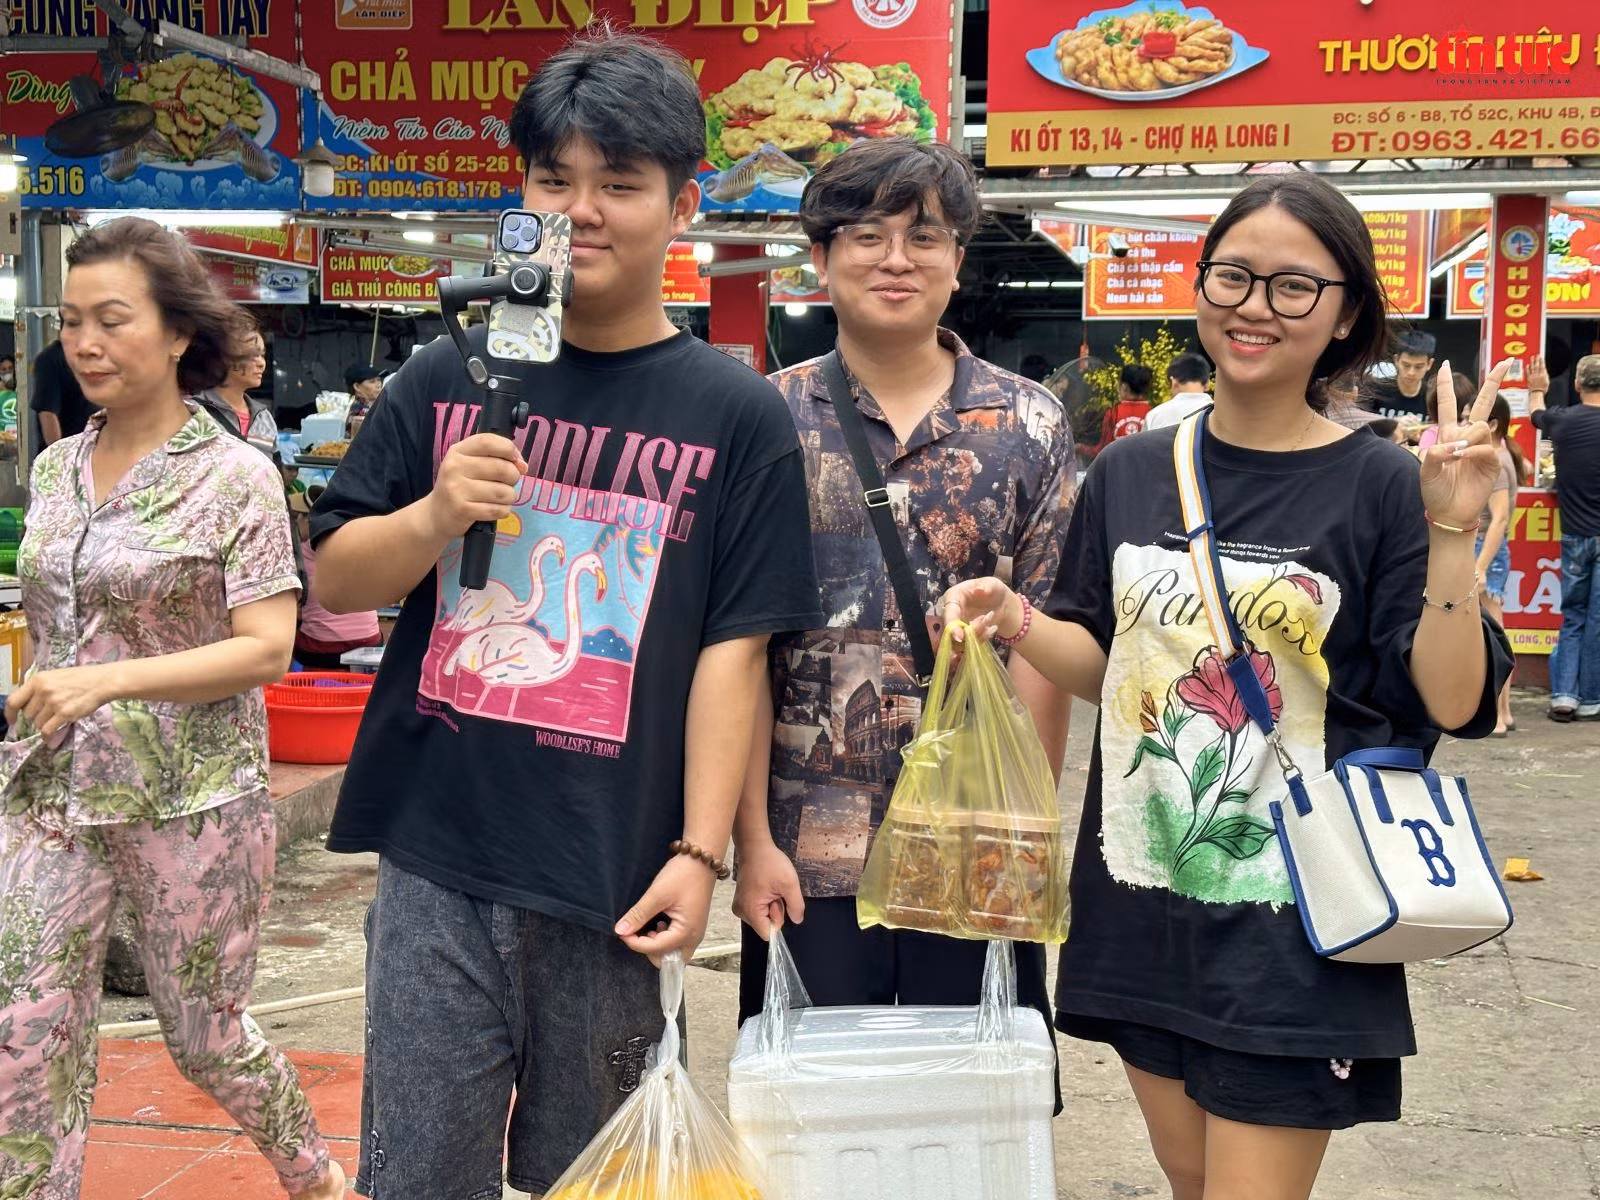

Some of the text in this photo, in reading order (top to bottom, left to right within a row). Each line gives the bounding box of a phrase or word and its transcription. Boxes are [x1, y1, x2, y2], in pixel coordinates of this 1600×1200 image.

[330, 48, 529, 110] CHẢ MỰC
[7, 70, 72, 113] Dùng
[1333, 112, 1361, 125] ĐC:
[1367, 107, 1390, 124] SỐ
[1396, 111, 1405, 123] 6
[1450, 104, 1473, 121] TỔ
[1478, 109, 1513, 122] 52C,
[1518, 107, 1552, 119] KHU
[433, 117, 475, 140] Của
[1010, 129, 1030, 152] KI
[1037, 120, 1062, 152] ỐT
[1070, 127, 1097, 154] 13,
[1104, 126, 1123, 150] 14
[1145, 124, 1186, 154] CHỢ
[1191, 124, 1217, 153] HẠ
[1226, 124, 1277, 148] LONG
[371, 156, 389, 172] KI
[394, 149, 418, 172] ỐT
[424, 149, 449, 172] SỐ
[455, 155, 509, 173] 25-26
[334, 180, 361, 198] ĐT:
[330, 251, 389, 275] CHẢ MỰC
[356, 277, 381, 297] THỦ
[385, 279, 421, 297] CÔNG
[593, 742, 621, 759] HOME
[1401, 818, 1456, 888] B
